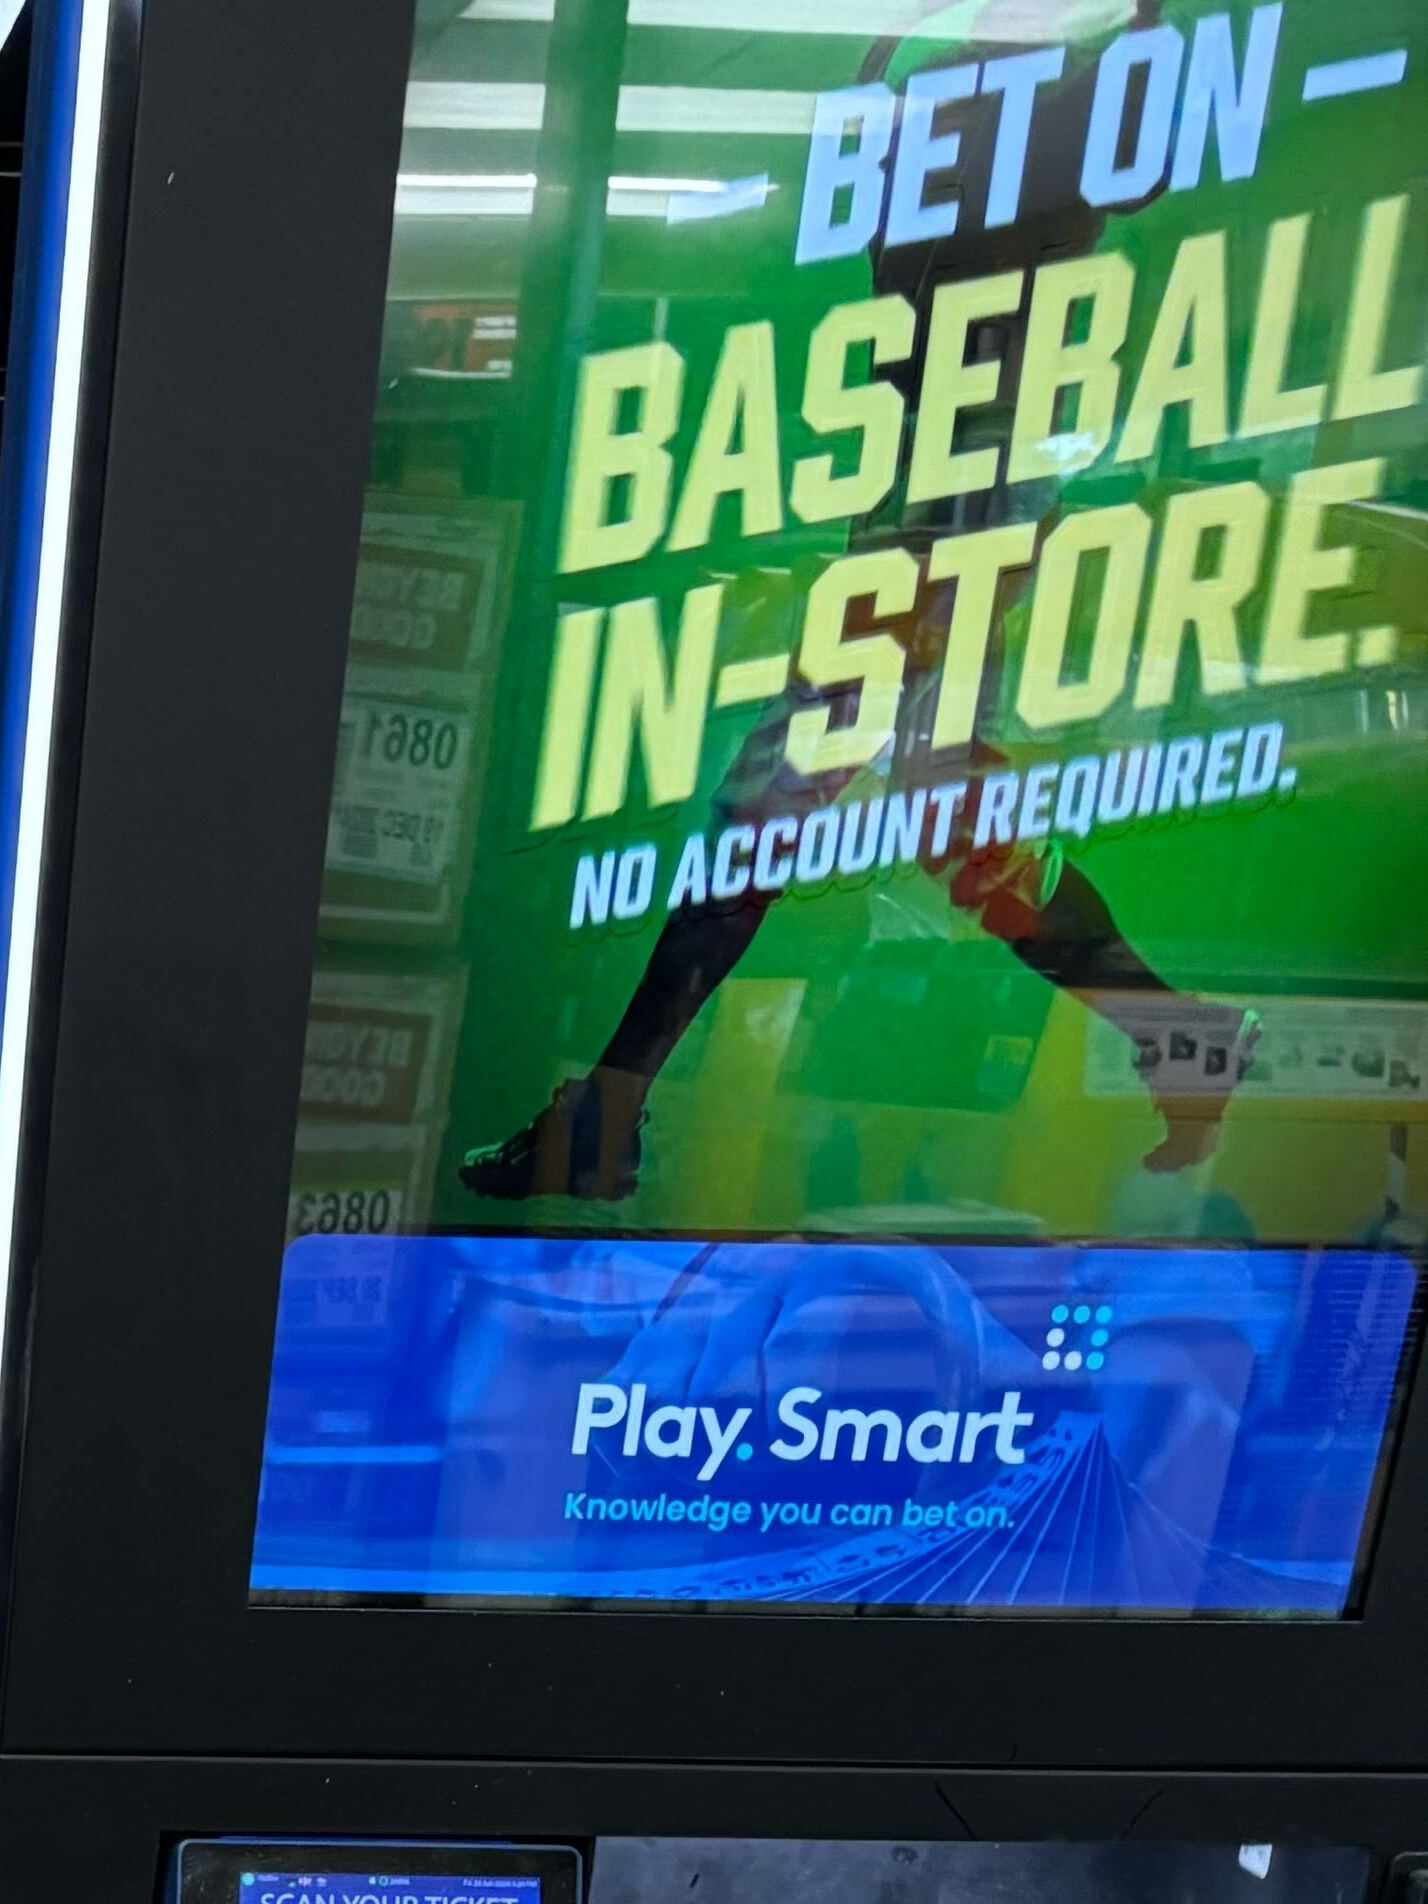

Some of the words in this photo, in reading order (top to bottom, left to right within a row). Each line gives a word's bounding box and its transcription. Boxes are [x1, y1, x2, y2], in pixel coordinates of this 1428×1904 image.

[794, 46, 1065, 267] BET
[1079, 2, 1285, 207] ON
[559, 194, 1428, 574] BASEBALL
[529, 457, 1396, 831] IN-STORE.
[570, 842, 656, 928] NO
[667, 781, 966, 912] ACCOUNT
[972, 721, 1299, 850] REQUIRED.
[563, 1491, 752, 1531] Knowledge
[760, 1500, 822, 1534] you
[830, 1500, 894, 1527] can
[901, 1496, 955, 1528] bet
[962, 1504, 1016, 1530] on.
[570, 1384, 756, 1482] Play.
[770, 1388, 1034, 1464] Smart
